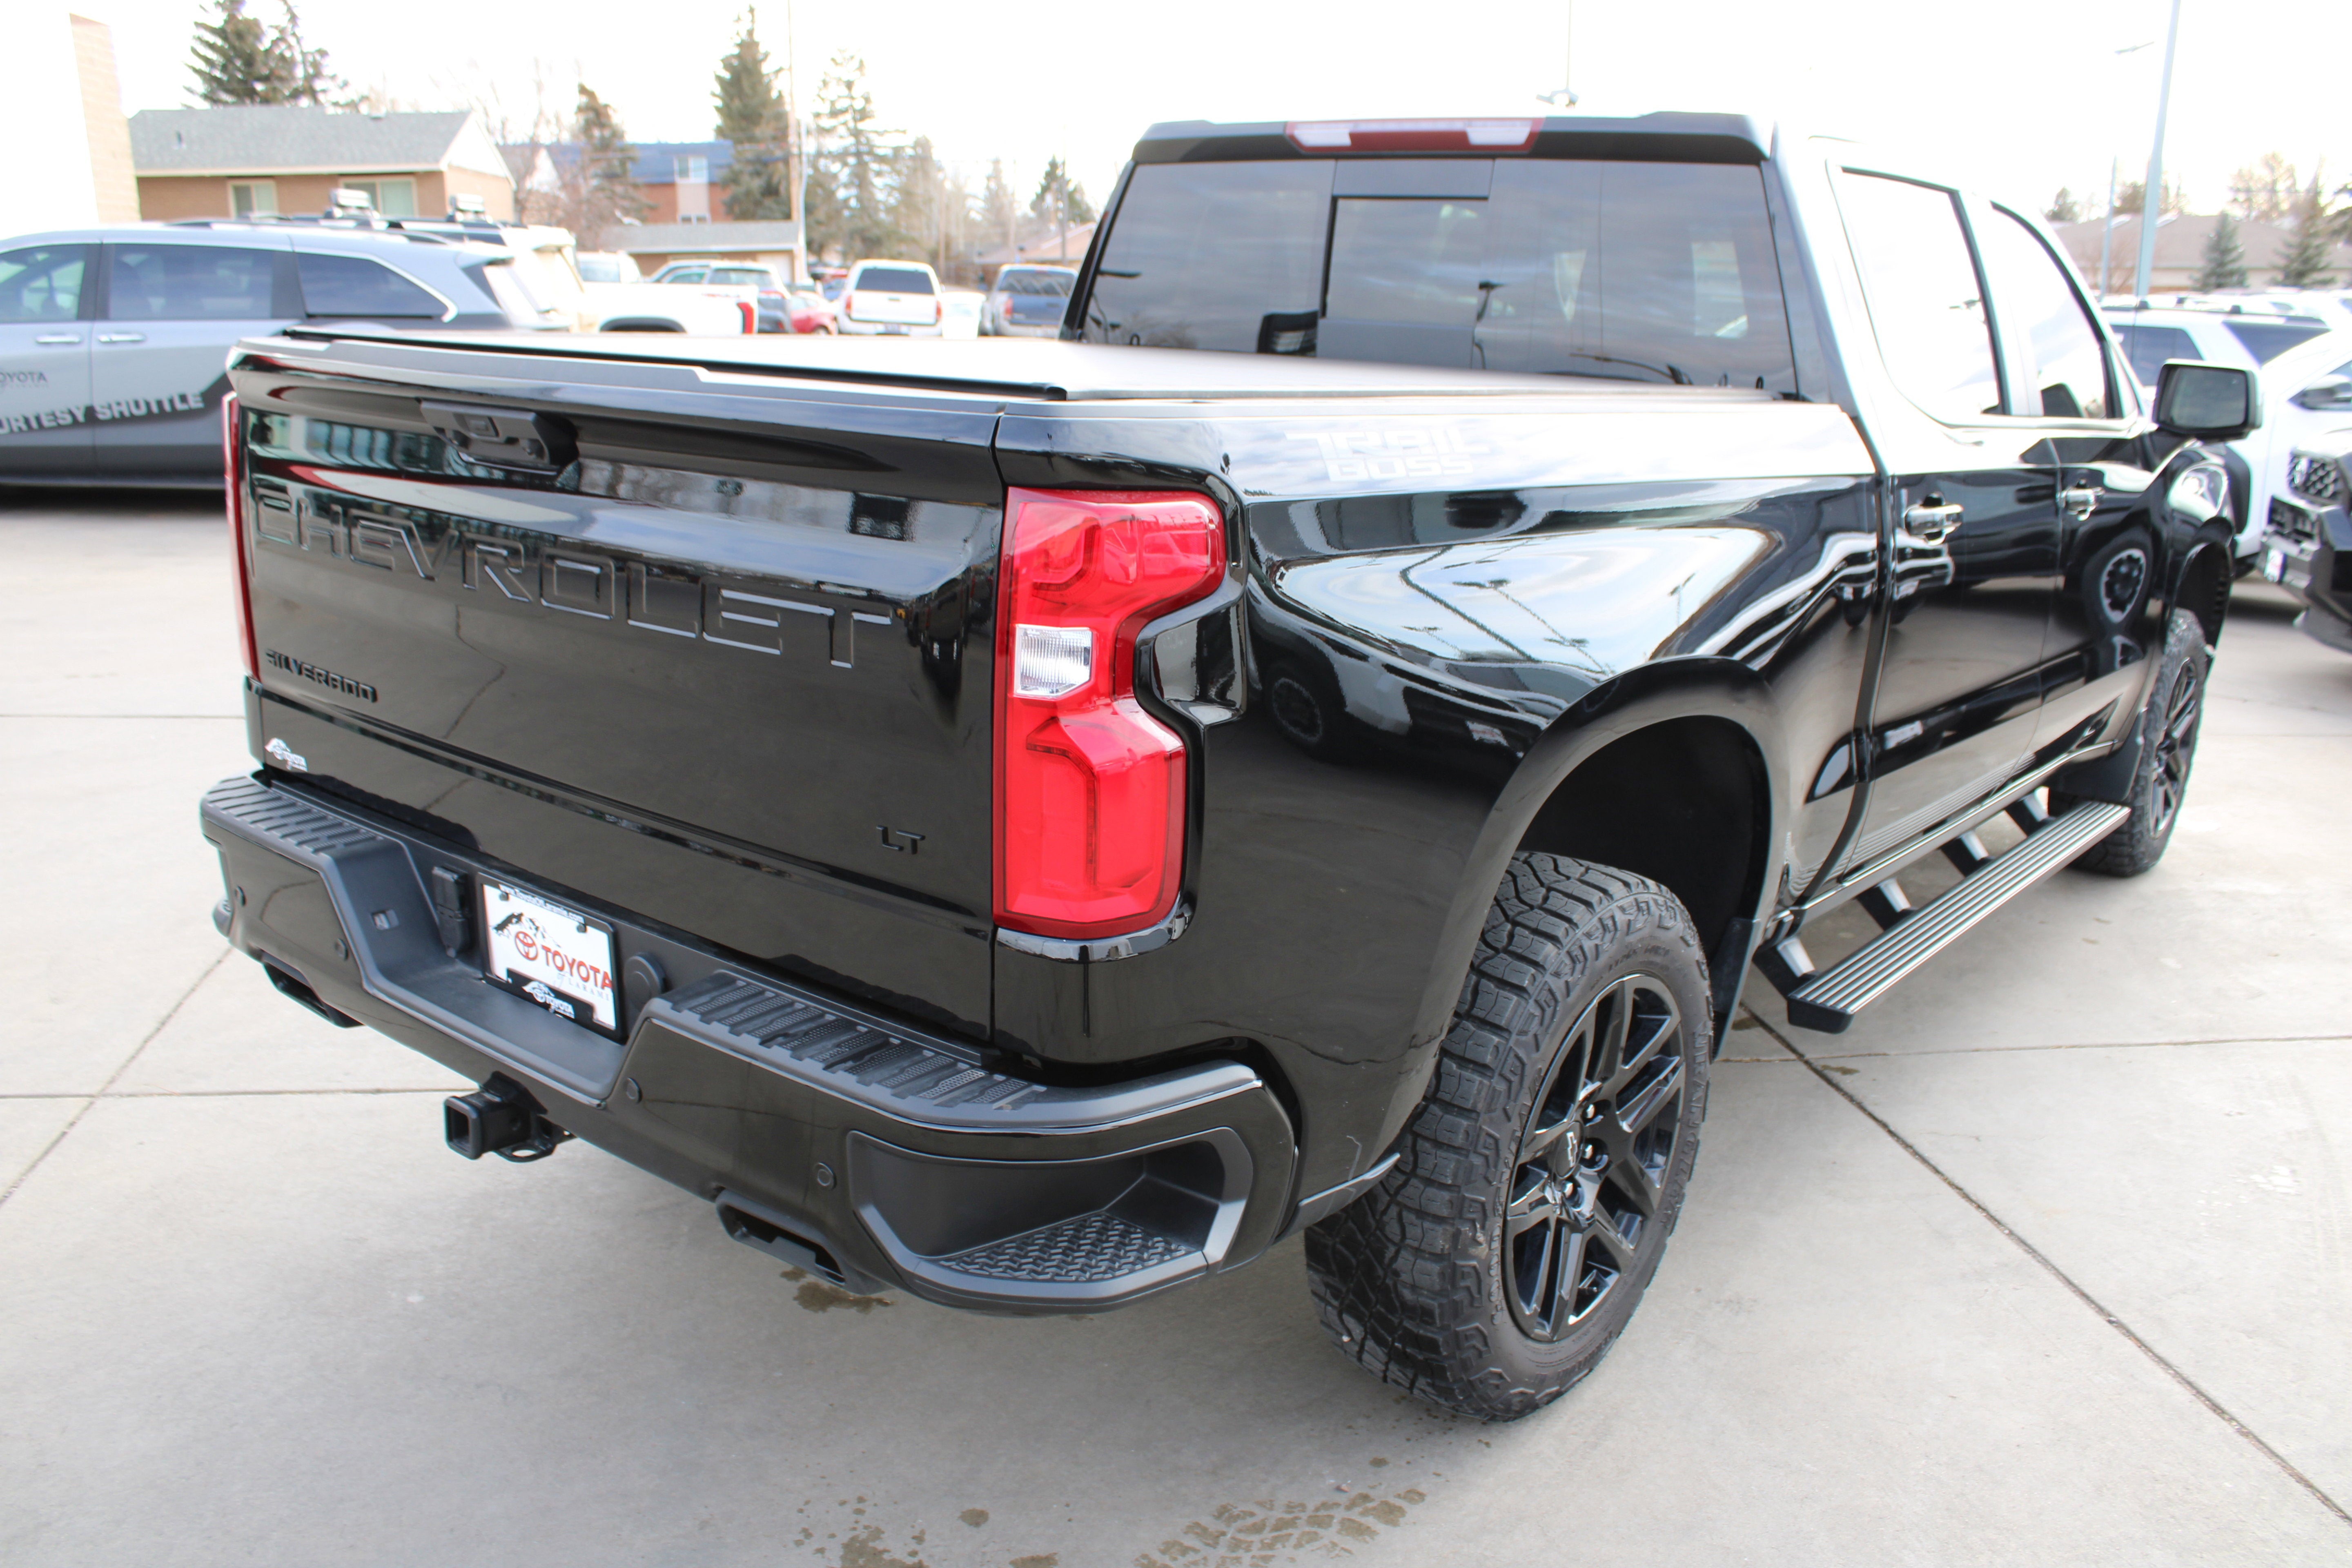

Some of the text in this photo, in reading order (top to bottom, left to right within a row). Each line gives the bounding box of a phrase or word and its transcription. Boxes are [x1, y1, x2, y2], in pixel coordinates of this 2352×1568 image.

[93, 392, 204, 420] SHUTTLE
[1284, 428, 1491, 459] TRAIL
[1323, 454, 1473, 482] BOSS
[254, 486, 893, 669] CHEVROLET
[265, 648, 379, 703] SILVERADO
[876, 825, 926, 855] LT
[541, 944, 612, 990] TOYOTA
[568, 976, 610, 1002] LARAMI
[1488, 1065, 1543, 1325] GOODYEAR
